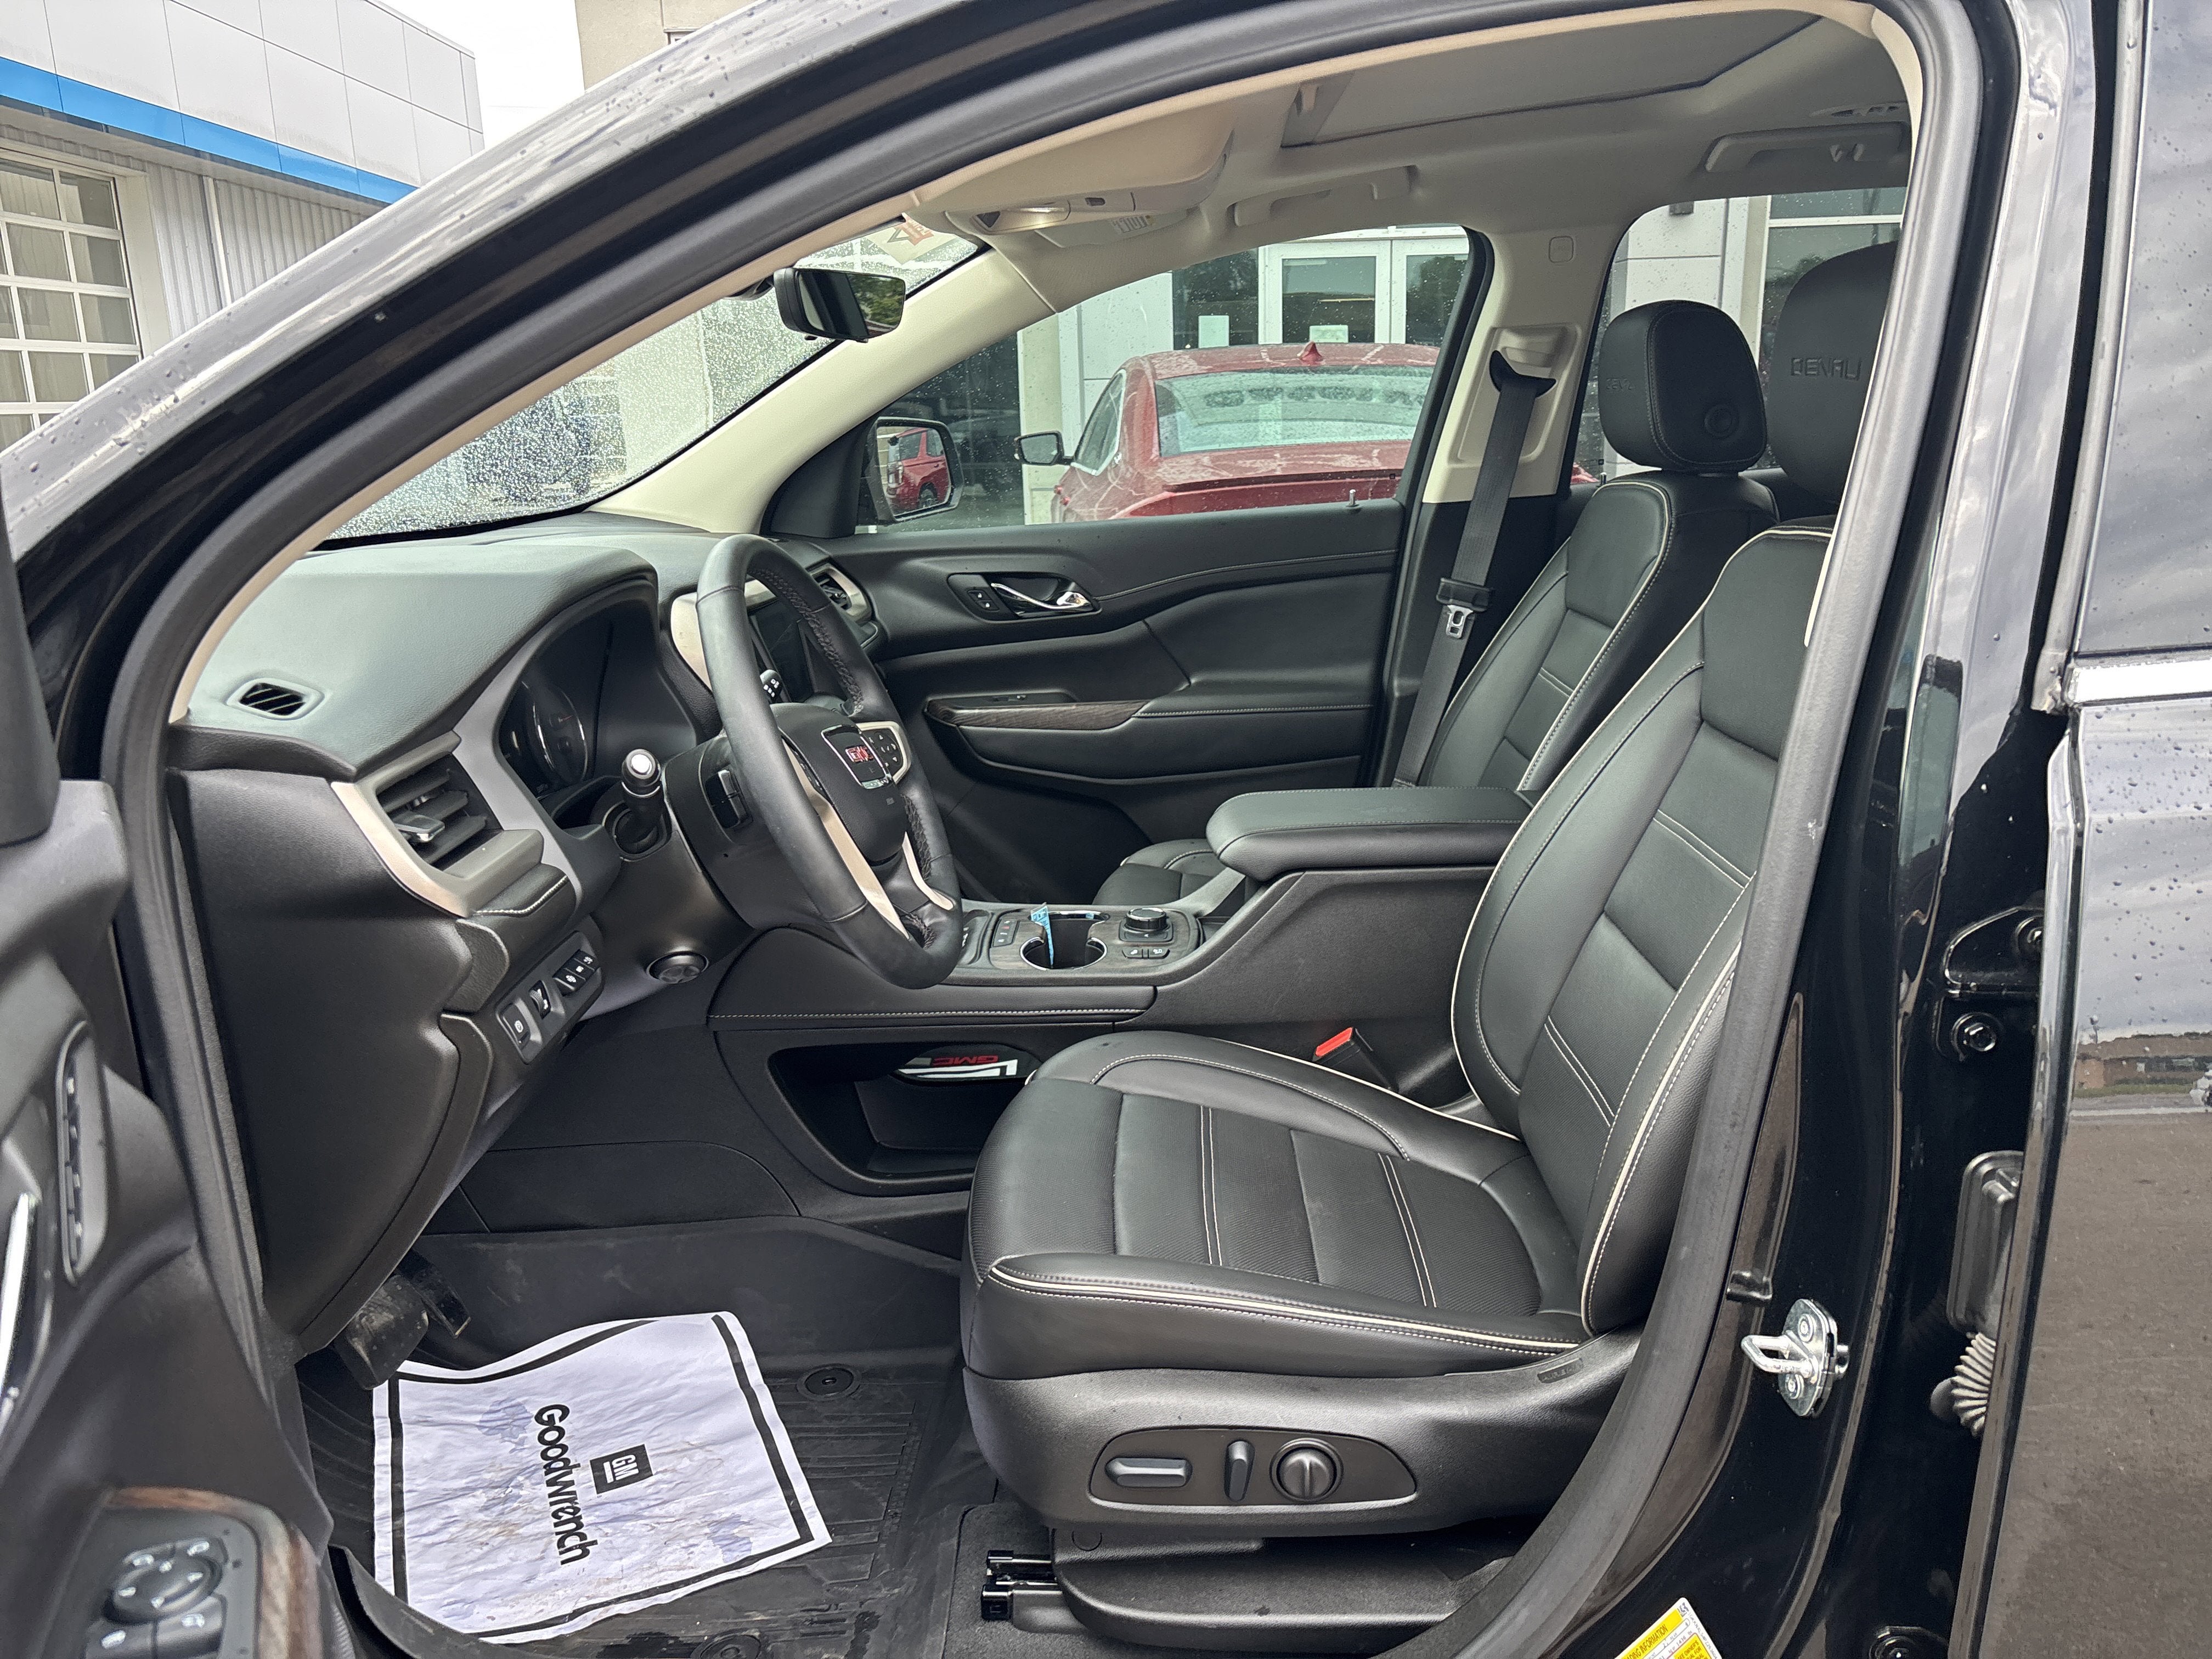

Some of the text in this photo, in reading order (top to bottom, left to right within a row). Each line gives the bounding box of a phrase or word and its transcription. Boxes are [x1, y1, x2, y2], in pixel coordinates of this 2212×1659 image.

[1791, 357, 1862, 381] DENALI
[612, 1454, 639, 1481] GM
[534, 1404, 598, 1565] Goodwrench
[1639, 1624, 1668, 1654] INFORMATION
